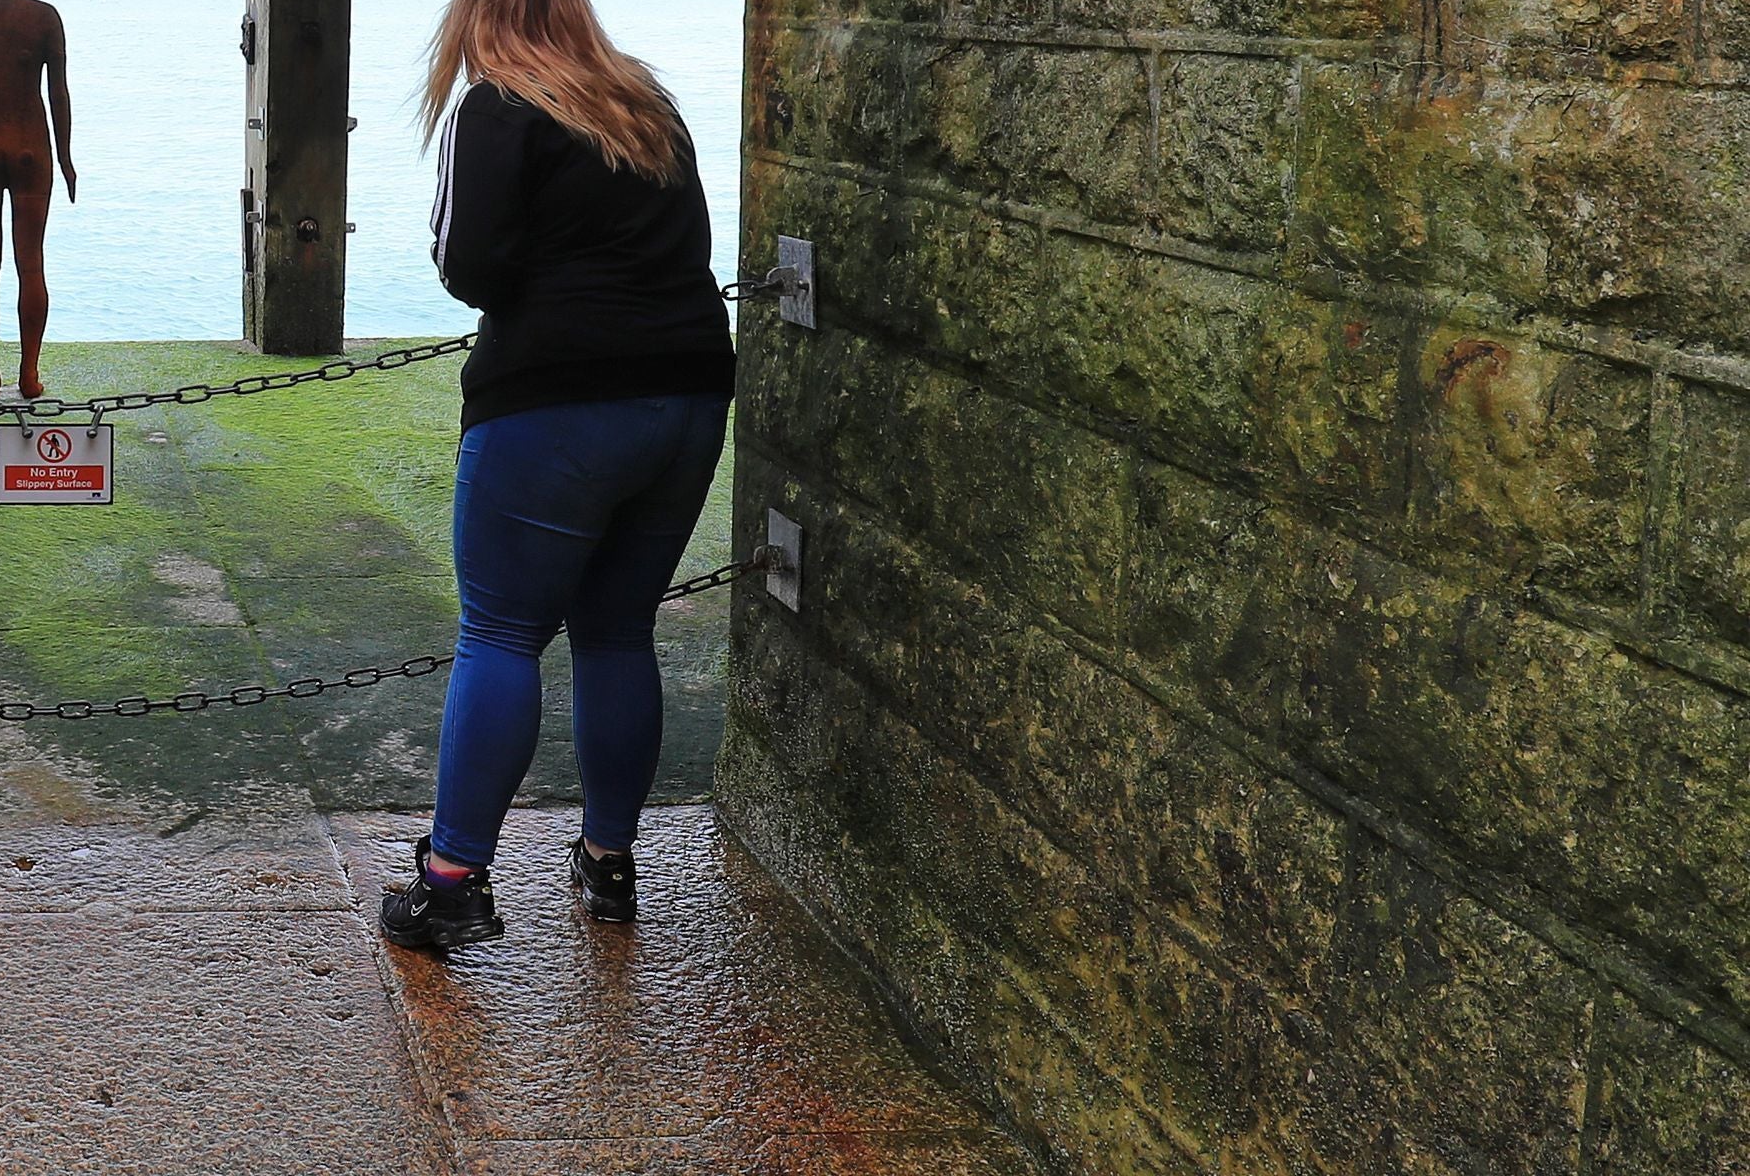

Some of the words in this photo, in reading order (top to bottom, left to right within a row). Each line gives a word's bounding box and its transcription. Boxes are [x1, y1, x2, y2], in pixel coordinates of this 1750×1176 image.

[30, 468, 46, 477] No
[49, 468, 78, 479] Entry
[16, 480, 54, 490] Slippery
[57, 480, 92, 488] Surface
